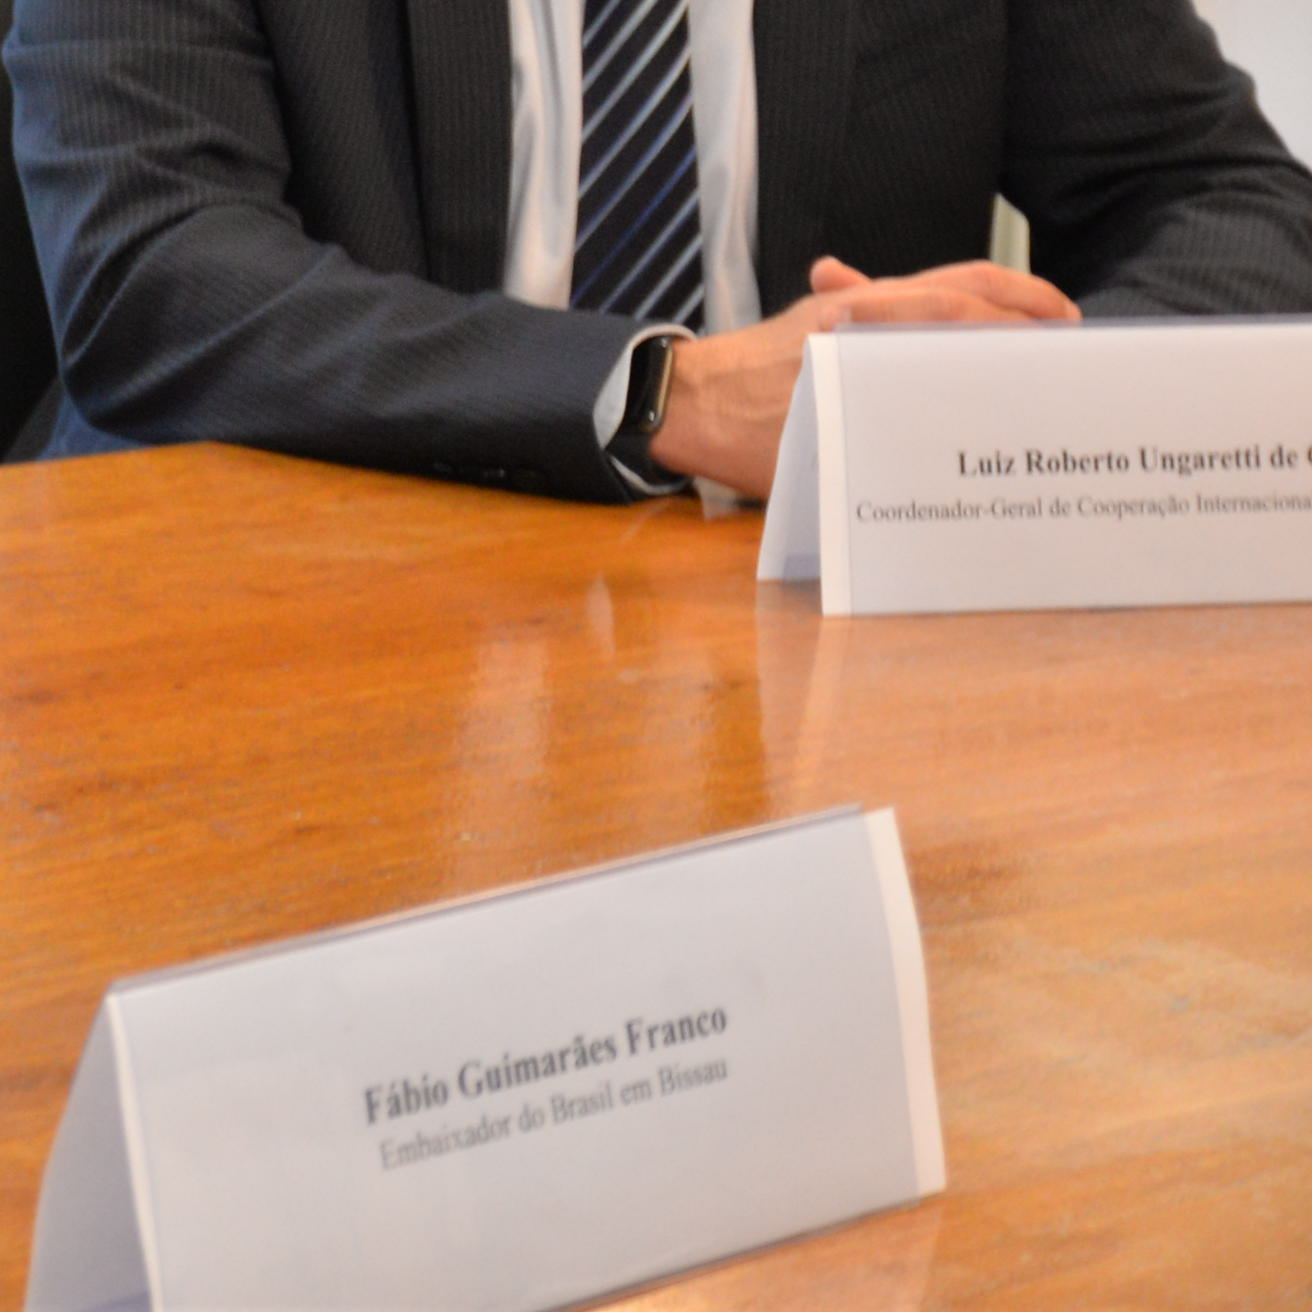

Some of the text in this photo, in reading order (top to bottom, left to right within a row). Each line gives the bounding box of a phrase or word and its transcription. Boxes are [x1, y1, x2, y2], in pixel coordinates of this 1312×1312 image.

[957, 449, 1016, 476] Luiz
[1025, 447, 1130, 476] Roberto
[1138, 443, 1262, 476] Ungaretti
[1269, 443, 1298, 469] de
[1049, 496, 1072, 518] de
[1077, 492, 1190, 520] Cooperação
[1196, 491, 1312, 514] Internaciona
[361, 1006, 728, 1126] Fábio Guimarães Franco
[378, 1057, 729, 1172] Embaixador do Brasil em Bissau
